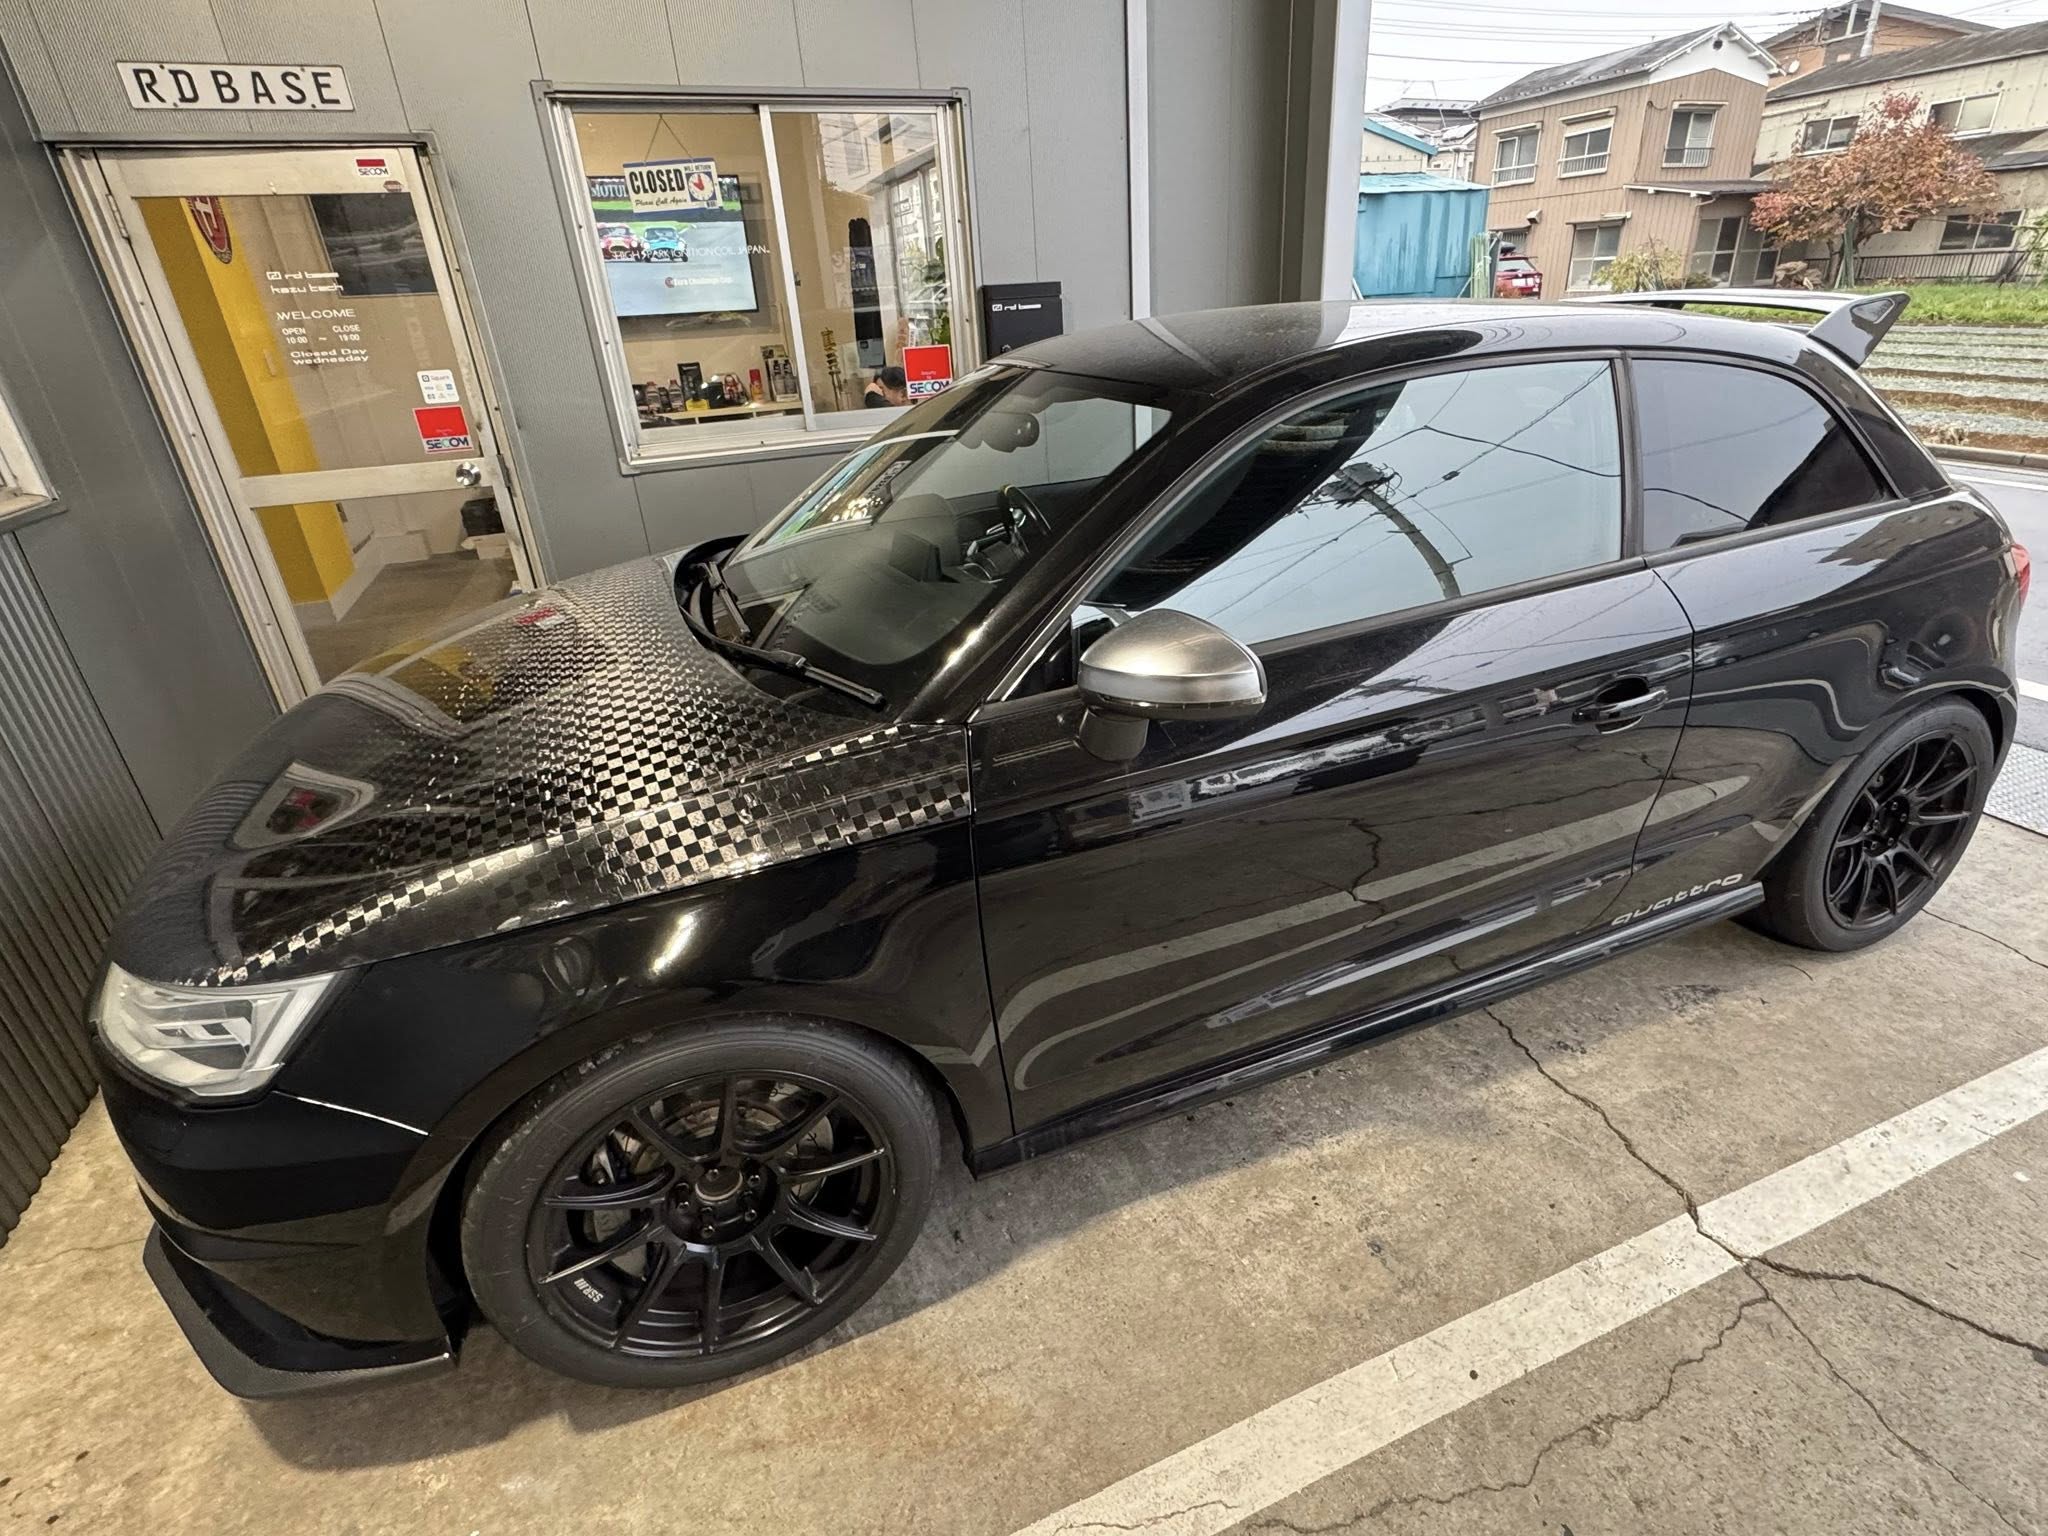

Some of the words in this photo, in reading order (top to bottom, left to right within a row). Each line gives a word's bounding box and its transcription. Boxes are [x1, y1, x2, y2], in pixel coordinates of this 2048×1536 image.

[210, 70, 341, 105] BASE
[358, 168, 389, 176] SECOM
[628, 168, 686, 195] CLOSED
[612, 250, 640, 260] HIGH
[641, 250, 670, 260] SPARK
[671, 247, 713, 259] IGNITION
[276, 308, 356, 320] WELCOME
[282, 327, 306, 335] OPEN
[332, 324, 361, 333] CLOSE
[286, 335, 309, 344] 10:00
[290, 349, 338, 358] Closed
[340, 348, 367, 356] Day
[909, 380, 950, 394] SECOM
[426, 437, 469, 450] SECOM
[1611, 873, 1743, 925] quattro
